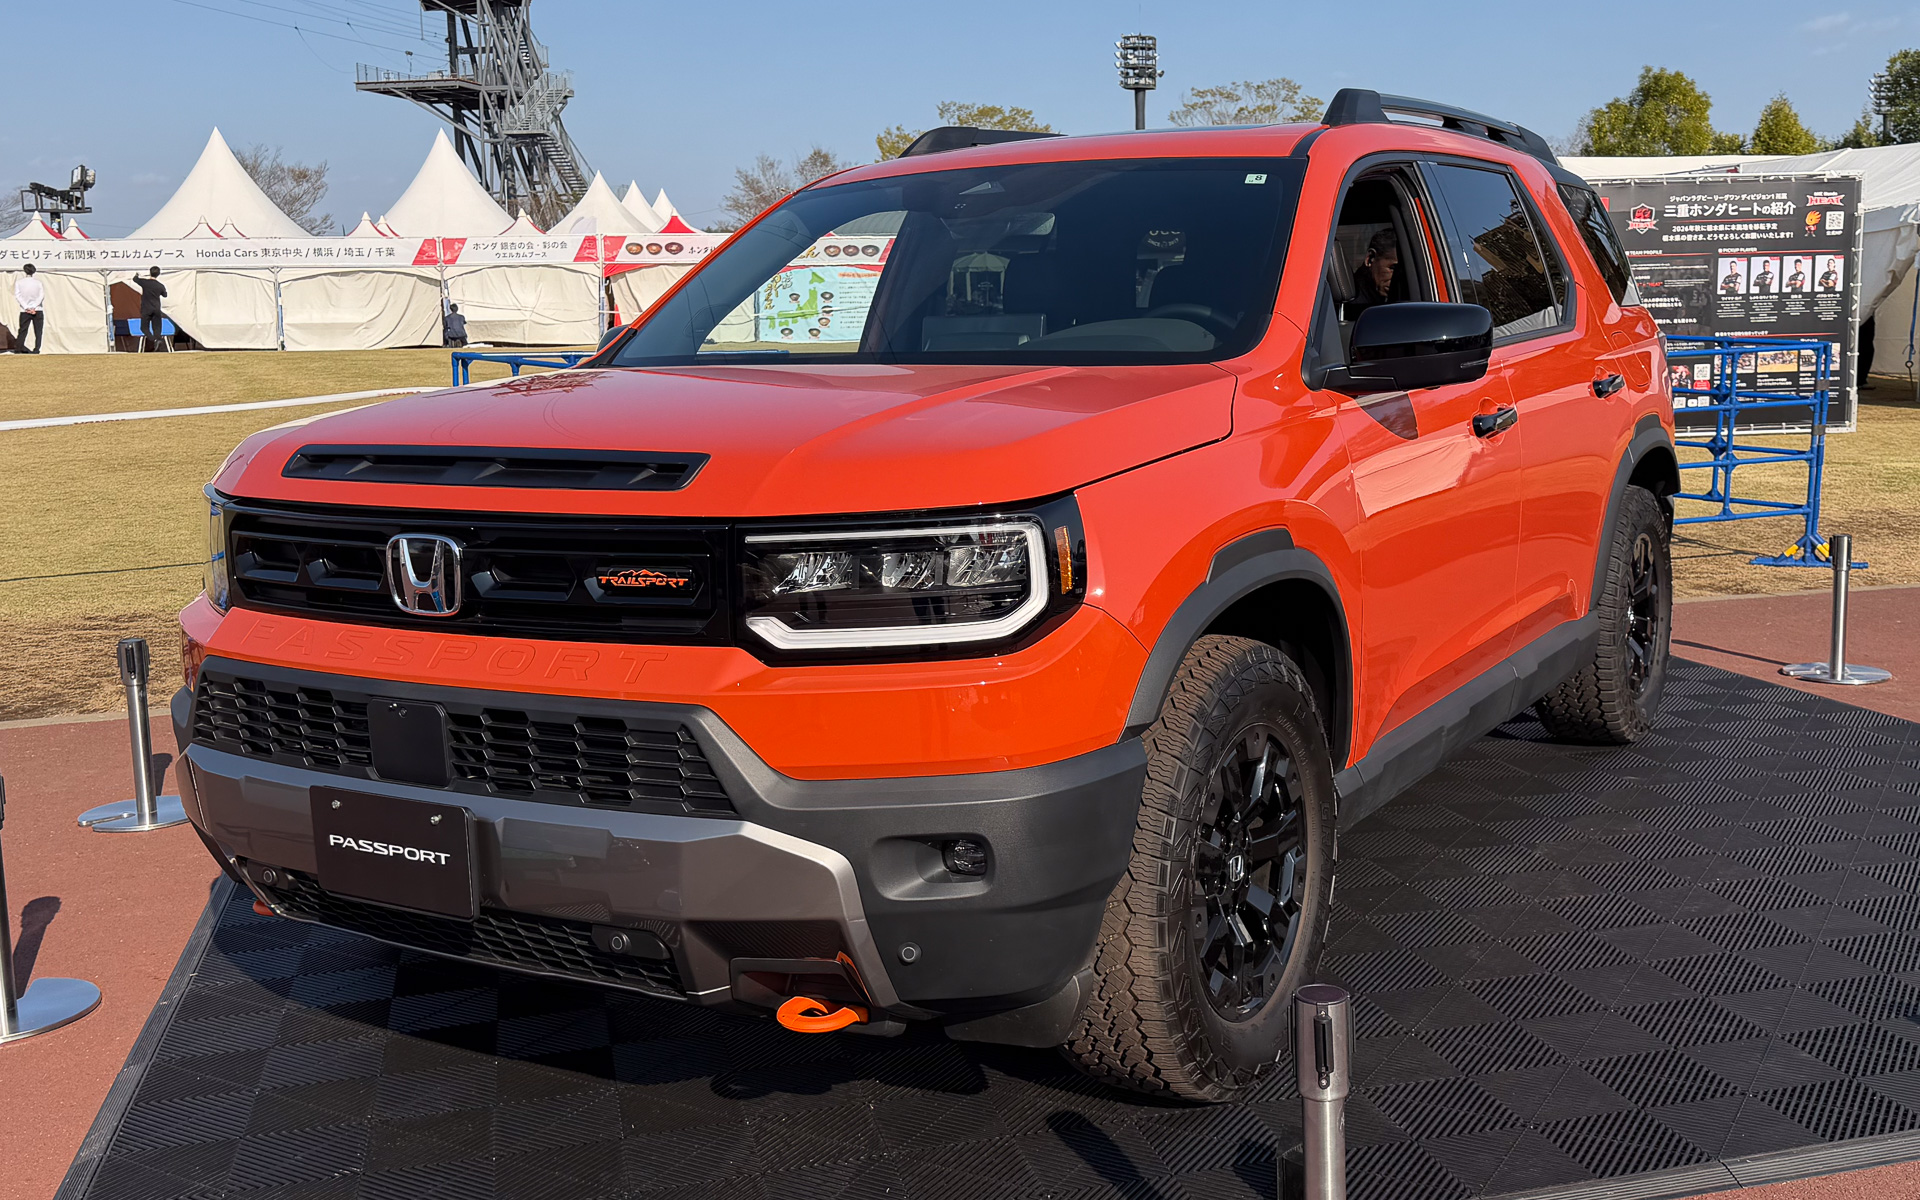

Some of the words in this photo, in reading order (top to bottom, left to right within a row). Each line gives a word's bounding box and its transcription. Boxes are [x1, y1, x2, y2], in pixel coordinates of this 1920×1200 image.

[1663, 201, 1797, 218] 三重ホンダヒートの紹介
[472, 242, 498, 251] ホンダ
[0, 249, 96, 260] ダモビリティ南関東
[100, 249, 185, 260] ウエルカムブース
[196, 248, 231, 258] Honda
[234, 248, 258, 258] Cars
[261, 247, 303, 258] 東京中央
[313, 247, 334, 257] 横浜
[344, 247, 365, 257] 埼玉
[375, 247, 395, 257] 千葉
[495, 251, 548, 259] ウエルカムブース
[598, 576, 689, 588] TRAILSPORT
[240, 618, 669, 685] PASSPORT
[329, 834, 451, 865] PASSPORT
